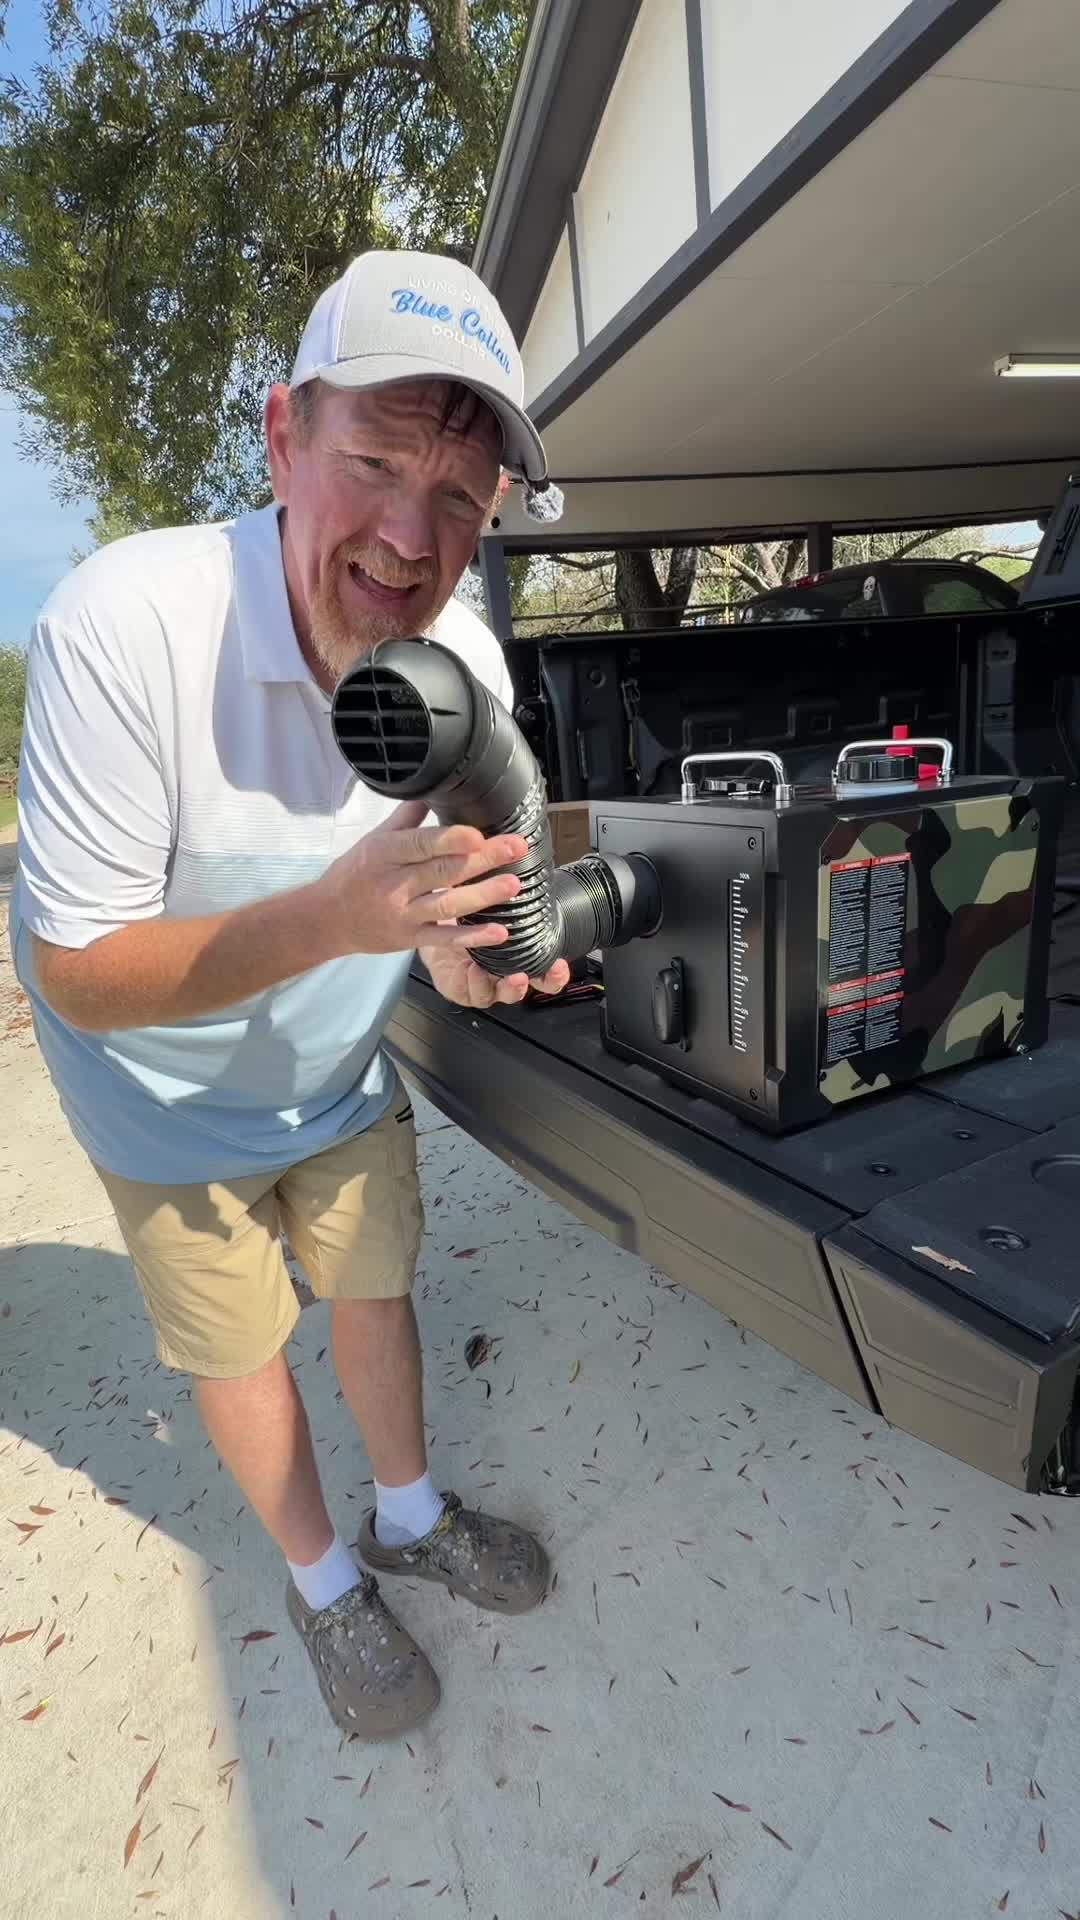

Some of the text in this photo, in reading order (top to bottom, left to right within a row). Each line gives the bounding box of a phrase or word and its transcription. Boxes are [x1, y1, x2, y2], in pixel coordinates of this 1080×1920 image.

[408, 274, 457, 296] LIVING
[391, 287, 453, 323] Blue
[459, 308, 513, 375] Collar
